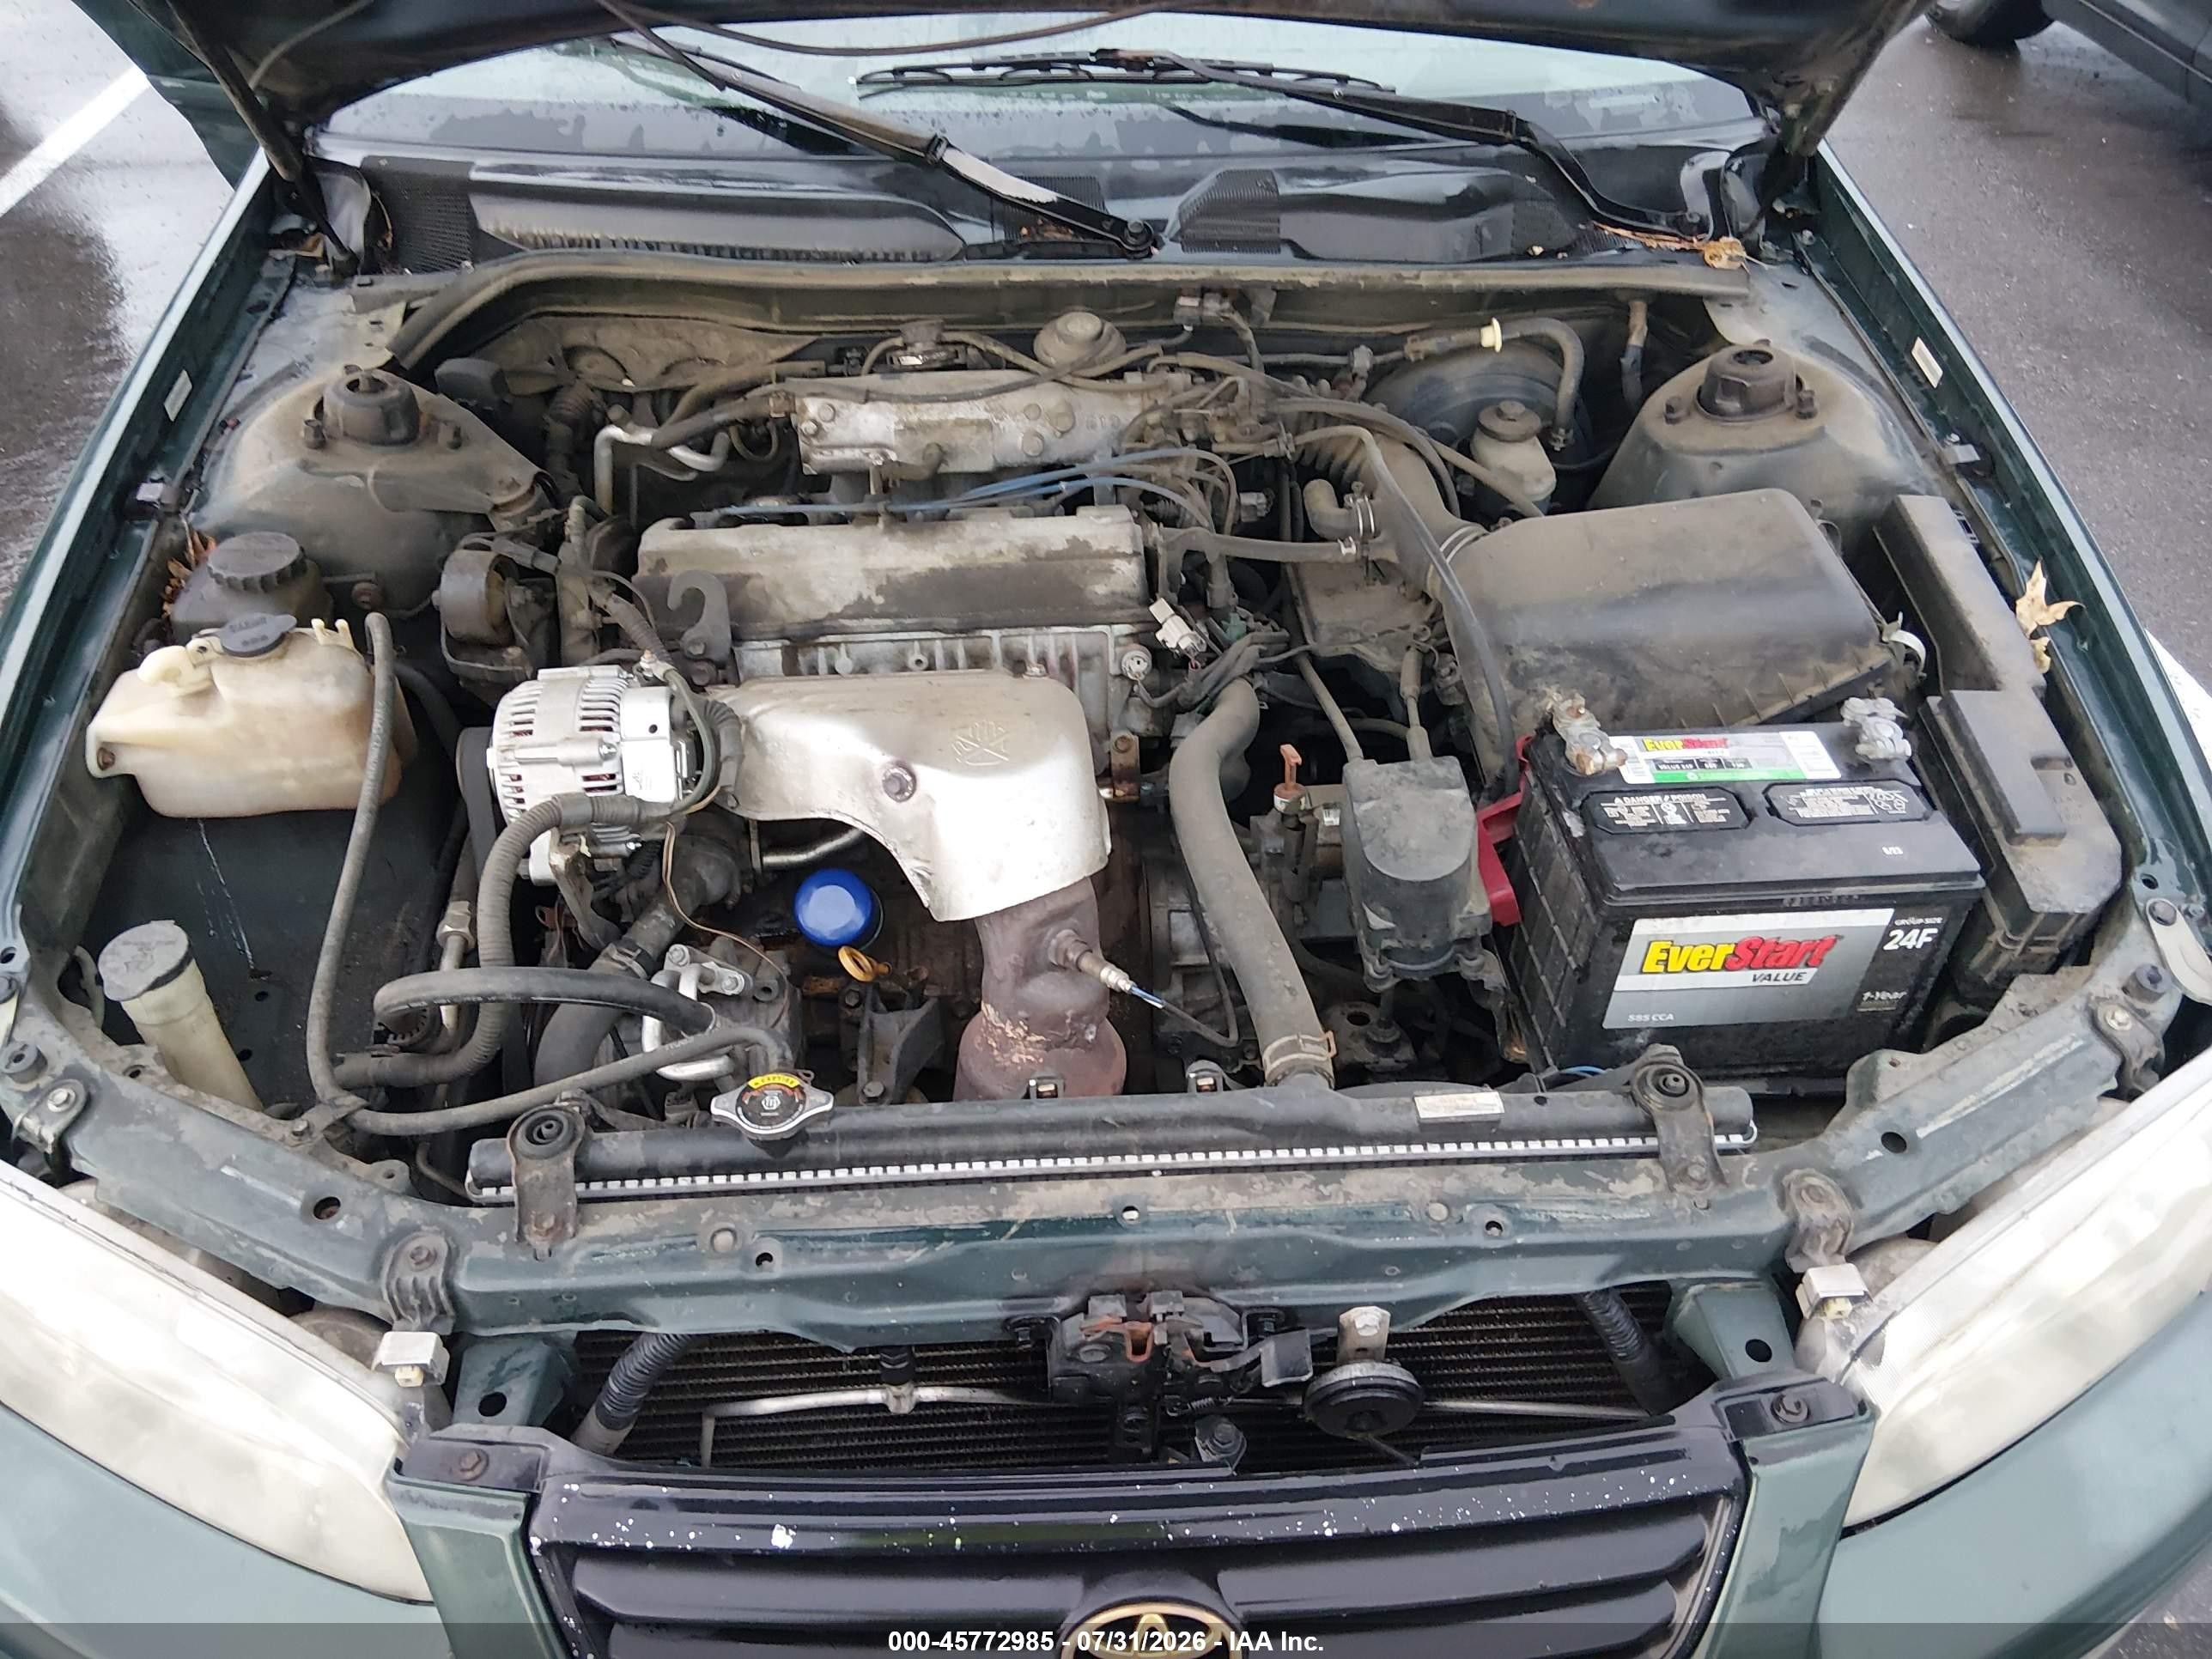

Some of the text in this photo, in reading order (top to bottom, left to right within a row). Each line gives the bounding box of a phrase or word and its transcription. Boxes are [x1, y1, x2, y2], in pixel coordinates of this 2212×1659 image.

[1882, 927, 1939, 951] 24F
[1641, 933, 1839, 975] EverStart
[1750, 970, 1808, 983] VALUE
[1651, 1012, 1674, 1022] CCA
